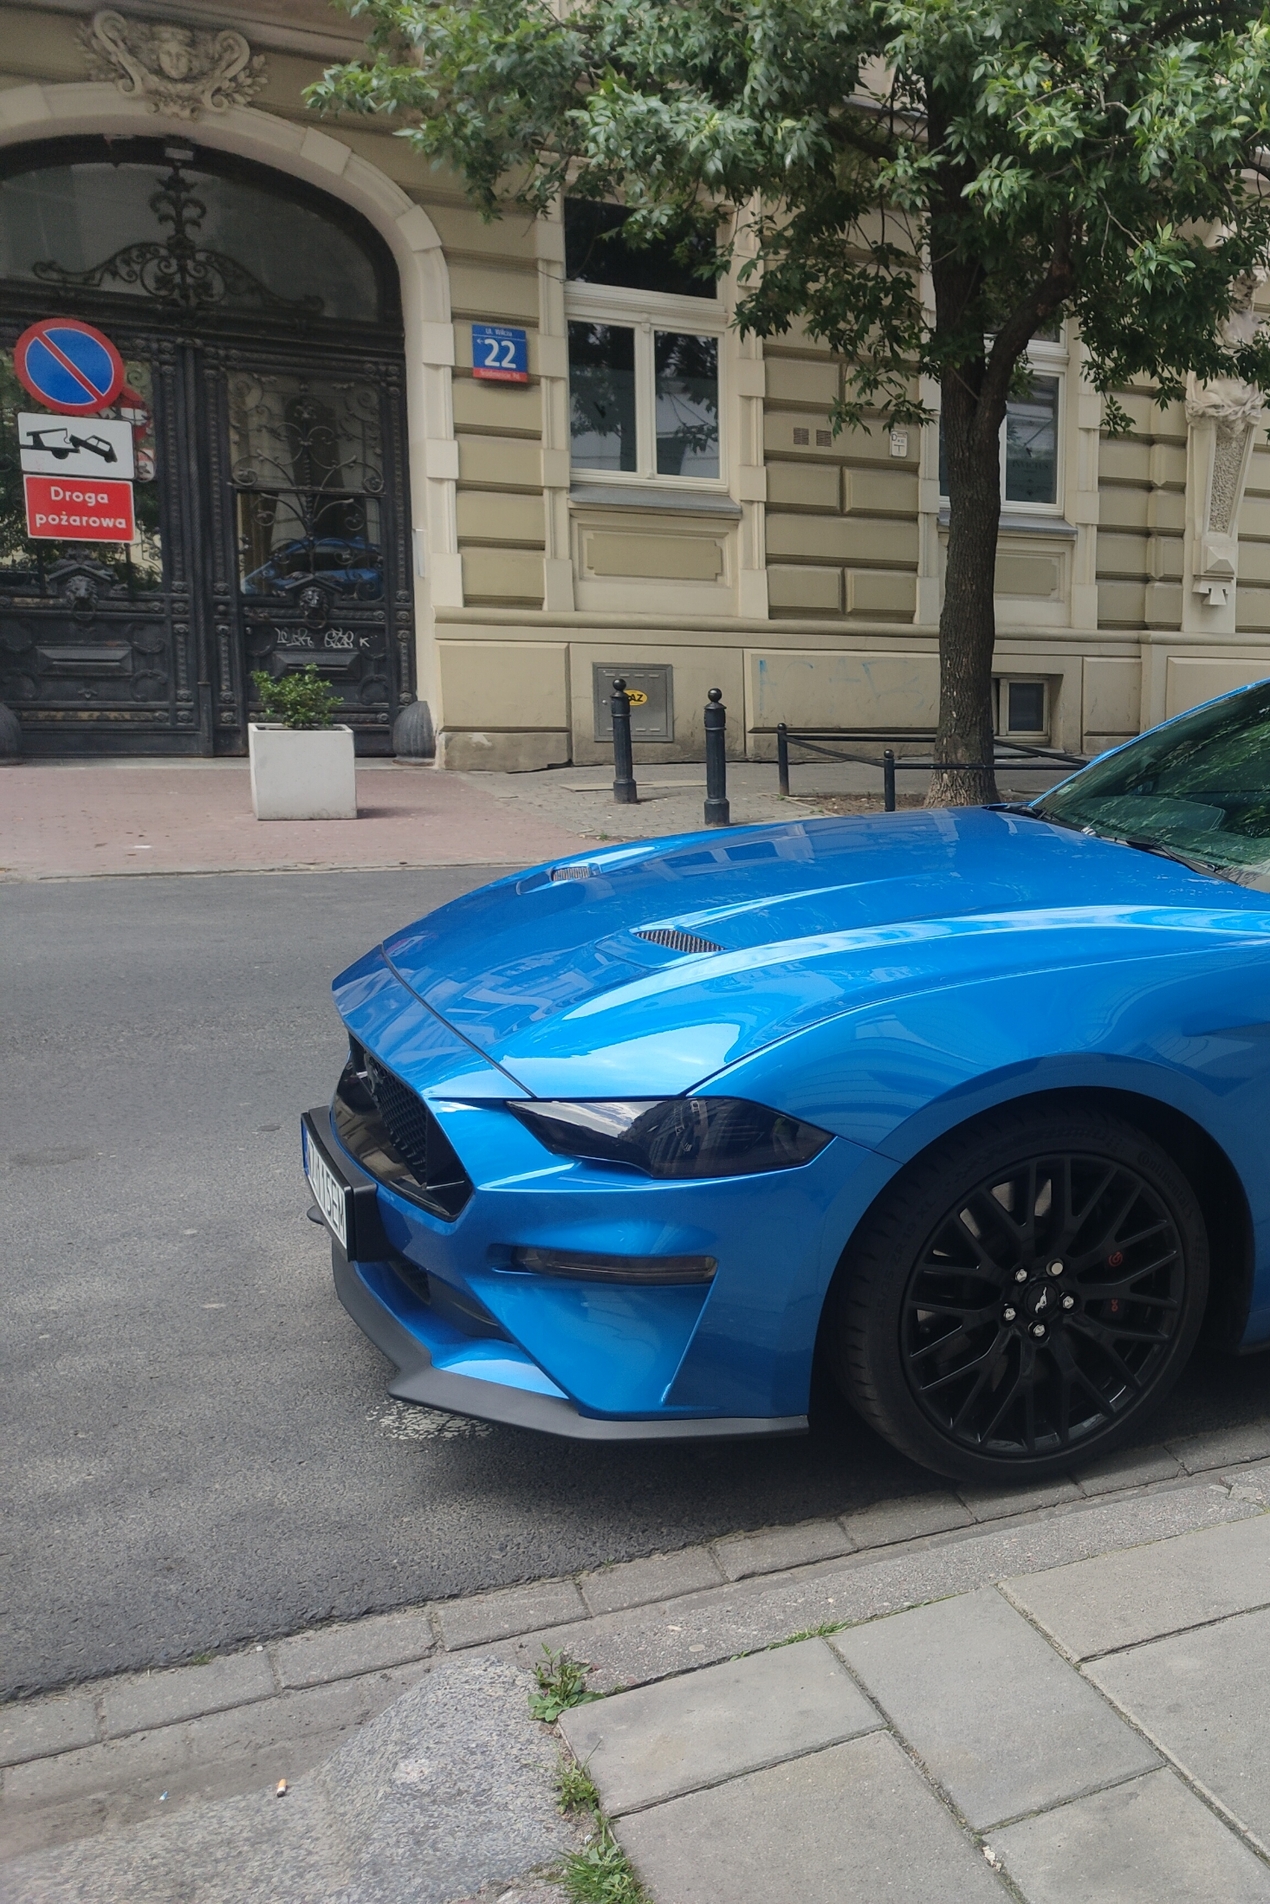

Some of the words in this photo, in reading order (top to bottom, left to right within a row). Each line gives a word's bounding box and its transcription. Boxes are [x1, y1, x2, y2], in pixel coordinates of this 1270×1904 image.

[484, 338, 516, 369] 22
[50, 485, 109, 507] Droga
[35, 510, 127, 529] pożarowa
[1136, 1149, 1190, 1211] Continental
